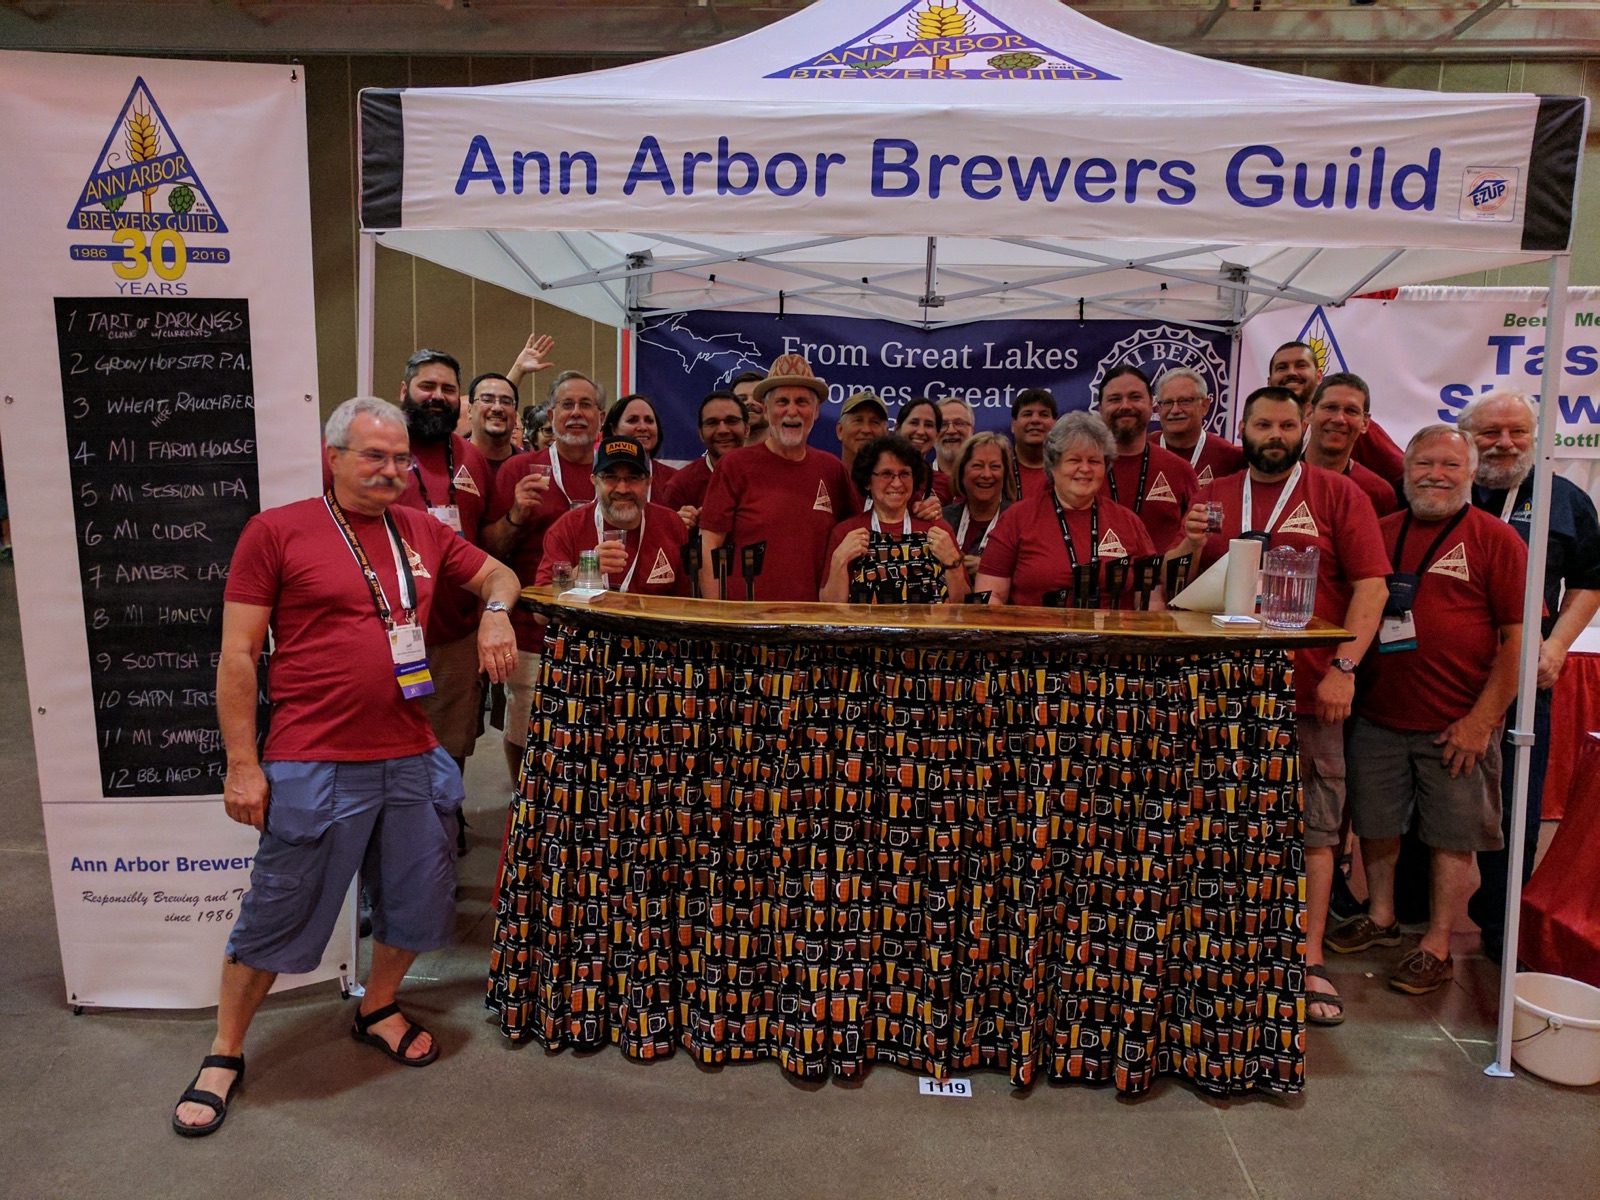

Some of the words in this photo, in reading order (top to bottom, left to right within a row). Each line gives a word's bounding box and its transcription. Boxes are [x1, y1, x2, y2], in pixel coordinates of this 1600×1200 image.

[812, 45, 898, 66] ANN
[904, 33, 1028, 56] ARBOR
[788, 69, 967, 80] BREWERS
[980, 69, 1098, 80] GUILD
[85, 174, 126, 203] ANN
[128, 154, 188, 192] ARBOR
[453, 133, 598, 197] Ann
[622, 133, 846, 198] Arbor
[871, 137, 1197, 206] Brewers
[1225, 143, 1442, 213] Guild
[77, 212, 161, 231] BREWERS
[165, 214, 219, 232] GUILD
[73, 248, 108, 259] 1986
[111, 228, 188, 281] 30
[192, 250, 227, 261] 2016
[114, 281, 189, 296] YEARS
[67, 310, 77, 333] 1
[87, 311, 135, 331] TART
[136, 317, 151, 330] OF
[154, 310, 243, 333] DARKNESS
[70, 352, 90, 376] 2
[149, 352, 214, 371] HOPSTER
[781, 336, 870, 367] From
[880, 341, 973, 370] Great
[981, 340, 1079, 371] Lakes
[1487, 335, 1600, 376] Tas
[818, 378, 912, 406] omes
[72, 396, 91, 420] 3
[107, 396, 170, 415] WHEAT
[174, 391, 256, 414] RAUCHBIER
[74, 440, 97, 466] 4
[108, 436, 135, 463] MI
[608, 442, 635, 451] ANVIL
[80, 482, 98, 507] 5
[110, 483, 134, 503] MI
[141, 481, 205, 499] SESSION
[213, 477, 249, 500] IPA
[85, 520, 102, 547] 6
[113, 518, 140, 541] MI
[152, 521, 213, 543] CIDER
[1120, 557, 1129, 566] 10
[1179, 557, 1189, 566] 12
[88, 564, 102, 590] 7
[115, 563, 190, 584] AMBER
[92, 607, 111, 630] 8
[123, 604, 145, 626] MI
[158, 606, 213, 626] HONEY
[96, 653, 113, 671] 9
[122, 651, 200, 671] SCOTTISH
[100, 690, 121, 710] 10
[182, 688, 218, 707] IRIS
[132, 729, 152, 747] MI
[108, 769, 136, 789] 12
[165, 766, 202, 784] AGED
[70, 856, 108, 872] Ann
[113, 856, 170, 872] Arbor
[176, 855, 253, 872] Brewer
[81, 890, 149, 906] Responsibly
[153, 890, 201, 907] Brewing
[204, 890, 229, 903] and
[164, 912, 192, 923] since
[197, 908, 234, 922] 1986
[926, 1081, 966, 1094] 1119
